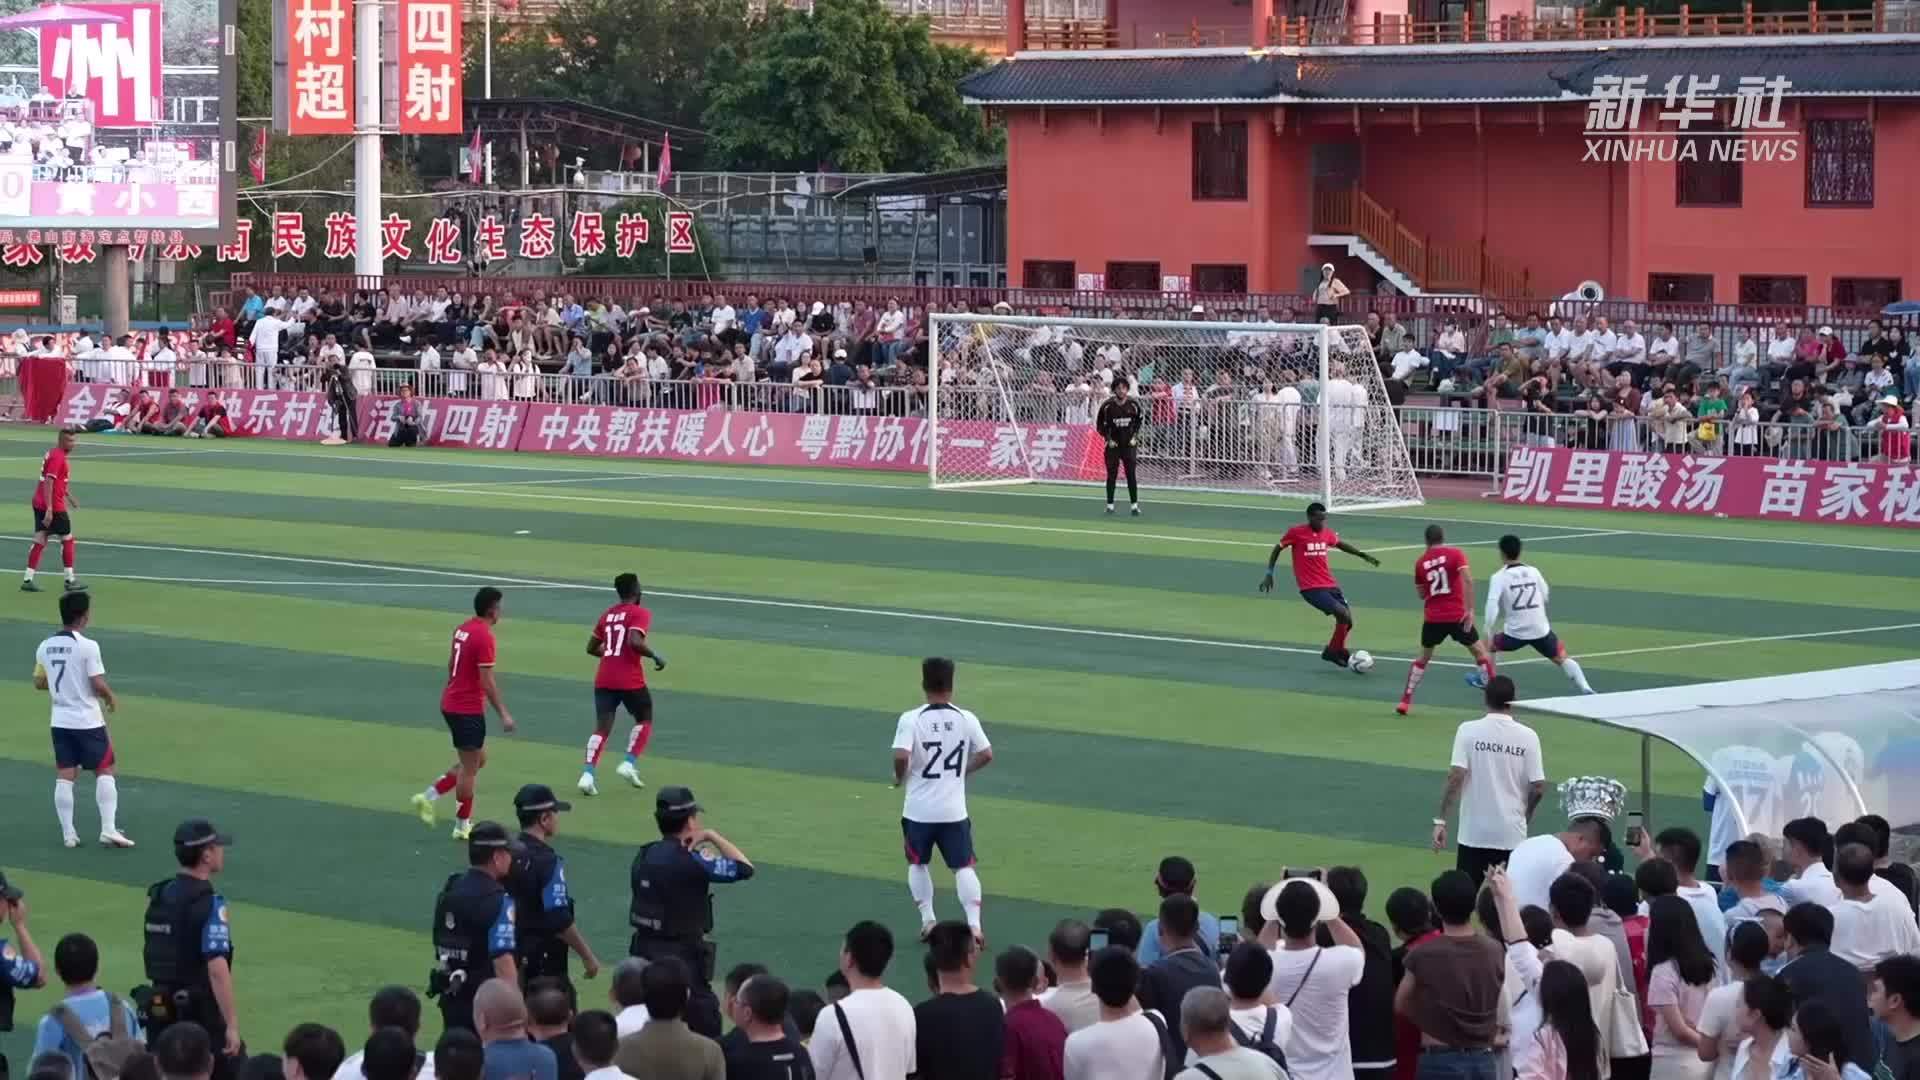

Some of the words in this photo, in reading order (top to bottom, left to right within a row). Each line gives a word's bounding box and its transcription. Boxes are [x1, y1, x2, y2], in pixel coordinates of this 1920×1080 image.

[52, 9, 151, 122] 州
[295, 0, 348, 120] 村超
[405, 3, 456, 121] 四射
[538, 406, 774, 457] 中央帮扶暖人心
[796, 414, 1069, 472] 粤黔协作一家亲
[1502, 446, 1727, 511] 凯里酸汤
[1426, 566, 1452, 597] 21
[1510, 582, 1540, 611] 22
[604, 623, 626, 657] 17
[51, 659, 66, 693] 7
[921, 740, 965, 779] 24
[1474, 740, 1503, 753] COACH
[1504, 745, 1527, 757] ALEX
